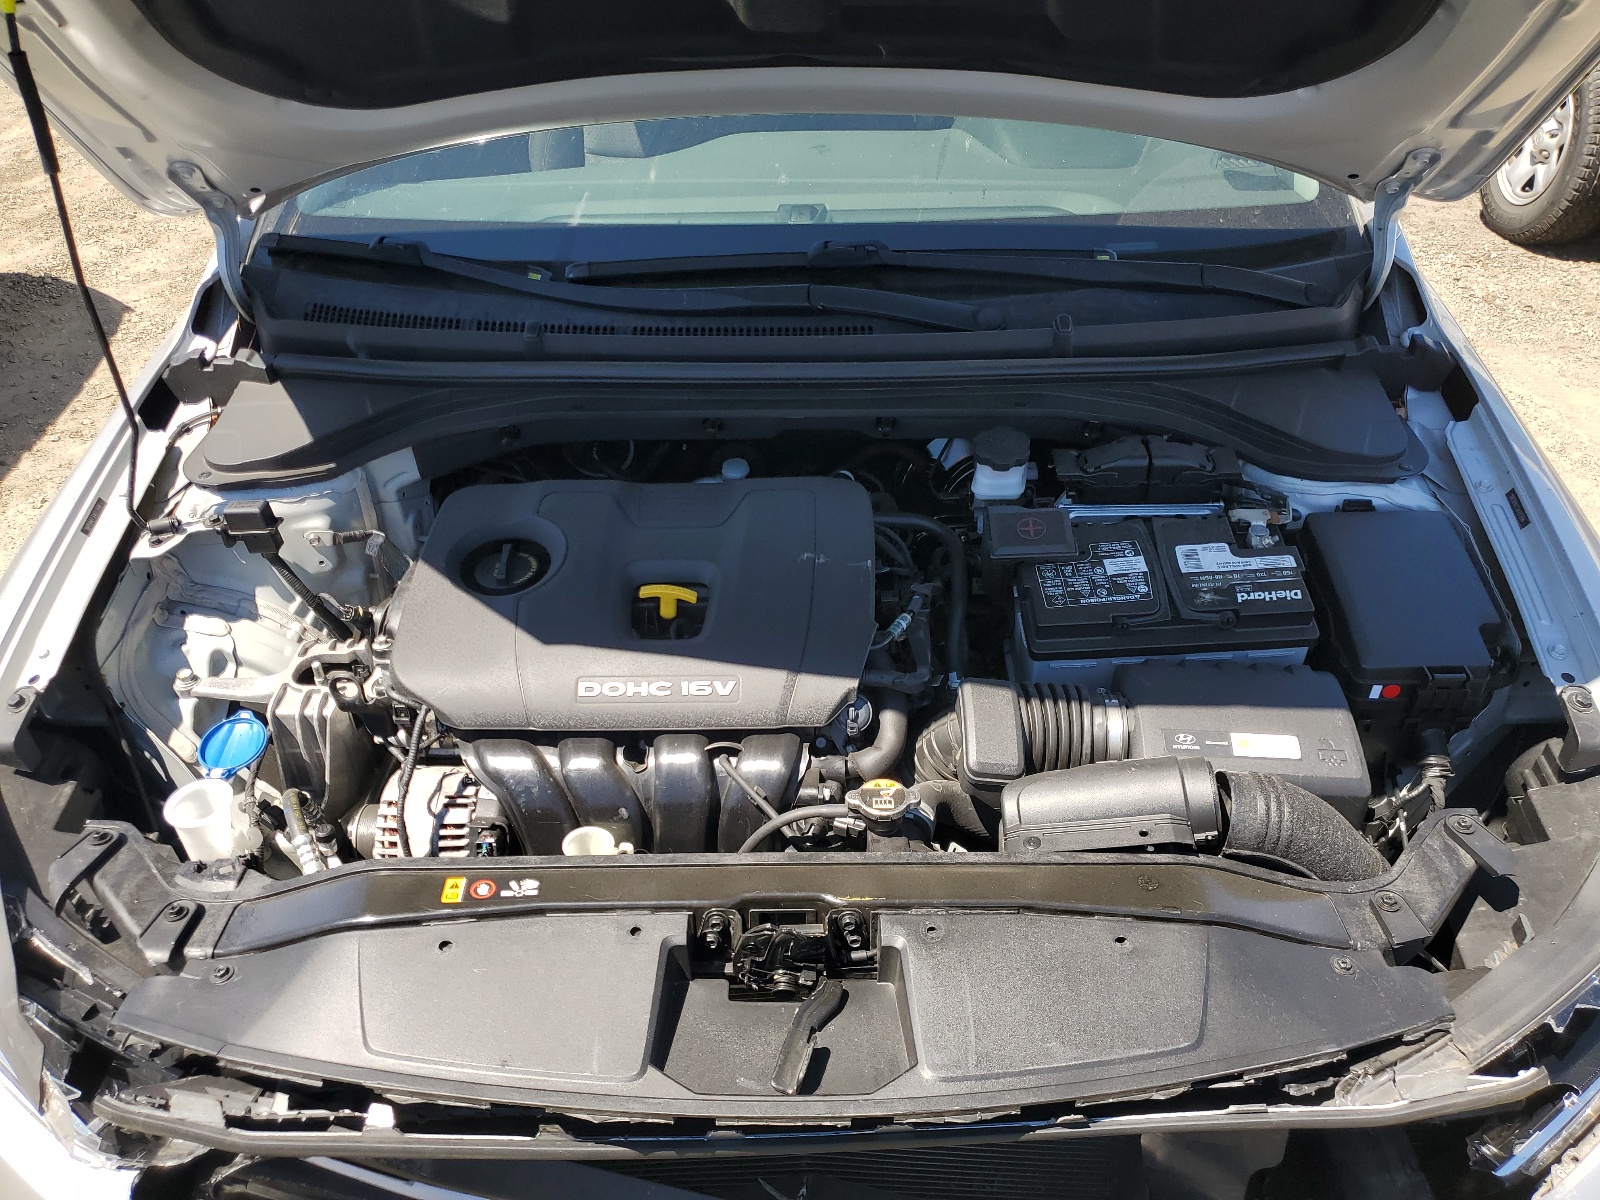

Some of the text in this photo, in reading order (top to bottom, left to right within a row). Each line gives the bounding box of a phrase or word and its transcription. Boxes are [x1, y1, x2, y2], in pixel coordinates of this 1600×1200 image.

[1237, 590, 1302, 603] DieHard
[577, 680, 737, 697] DOHC 16V
